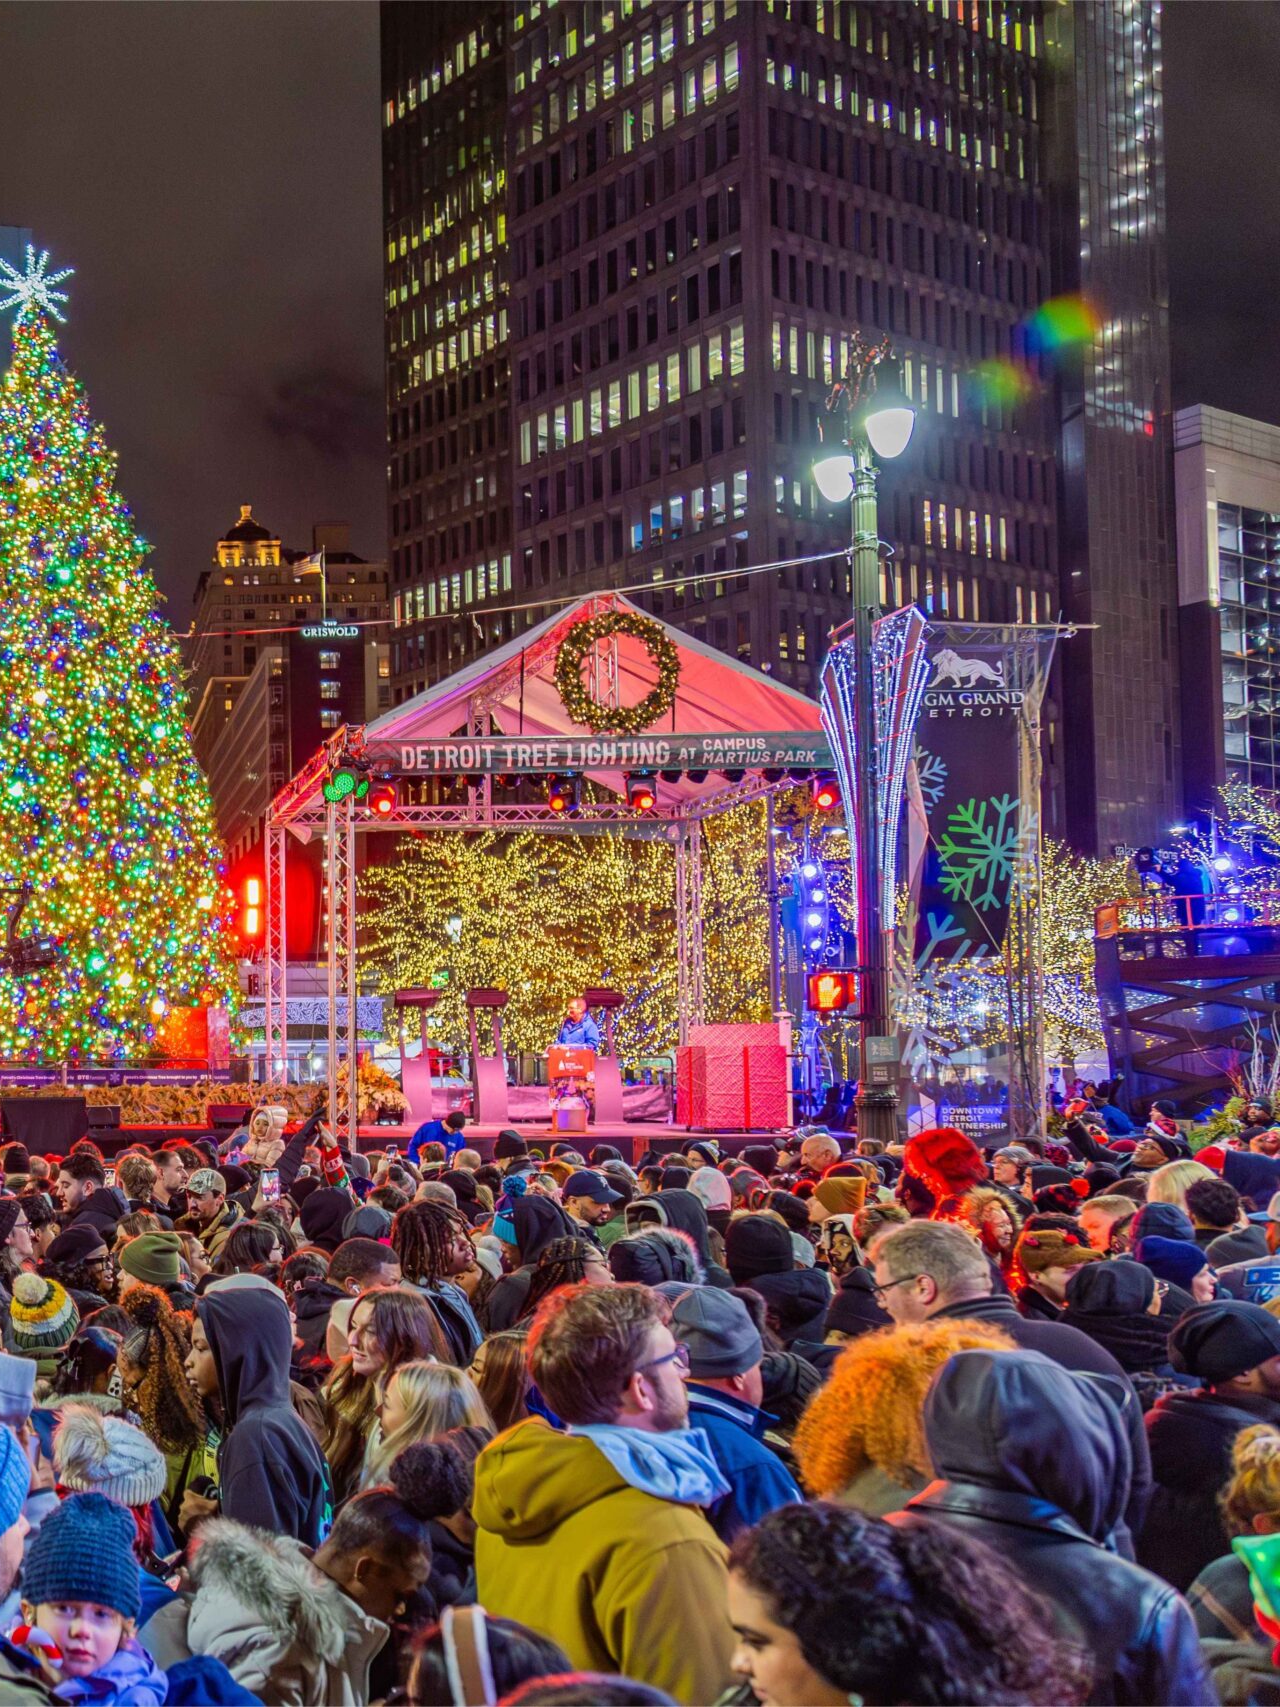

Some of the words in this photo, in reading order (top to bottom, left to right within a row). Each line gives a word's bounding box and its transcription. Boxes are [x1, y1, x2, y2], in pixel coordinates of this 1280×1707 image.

[303, 627, 359, 637] GRISWOLD
[921, 693, 955, 706] GM
[959, 692, 1024, 705] GRAND
[702, 738, 766, 751] CAMPUS
[401, 745, 495, 770] DETROIT
[502, 744, 560, 768] TREE
[566, 741, 670, 766] LIGHTING
[678, 747, 696, 760] AT
[702, 751, 771, 764] MARTIUS
[774, 750, 816, 763] PARK
[943, 1122, 1008, 1130] PARTNERSHIP
